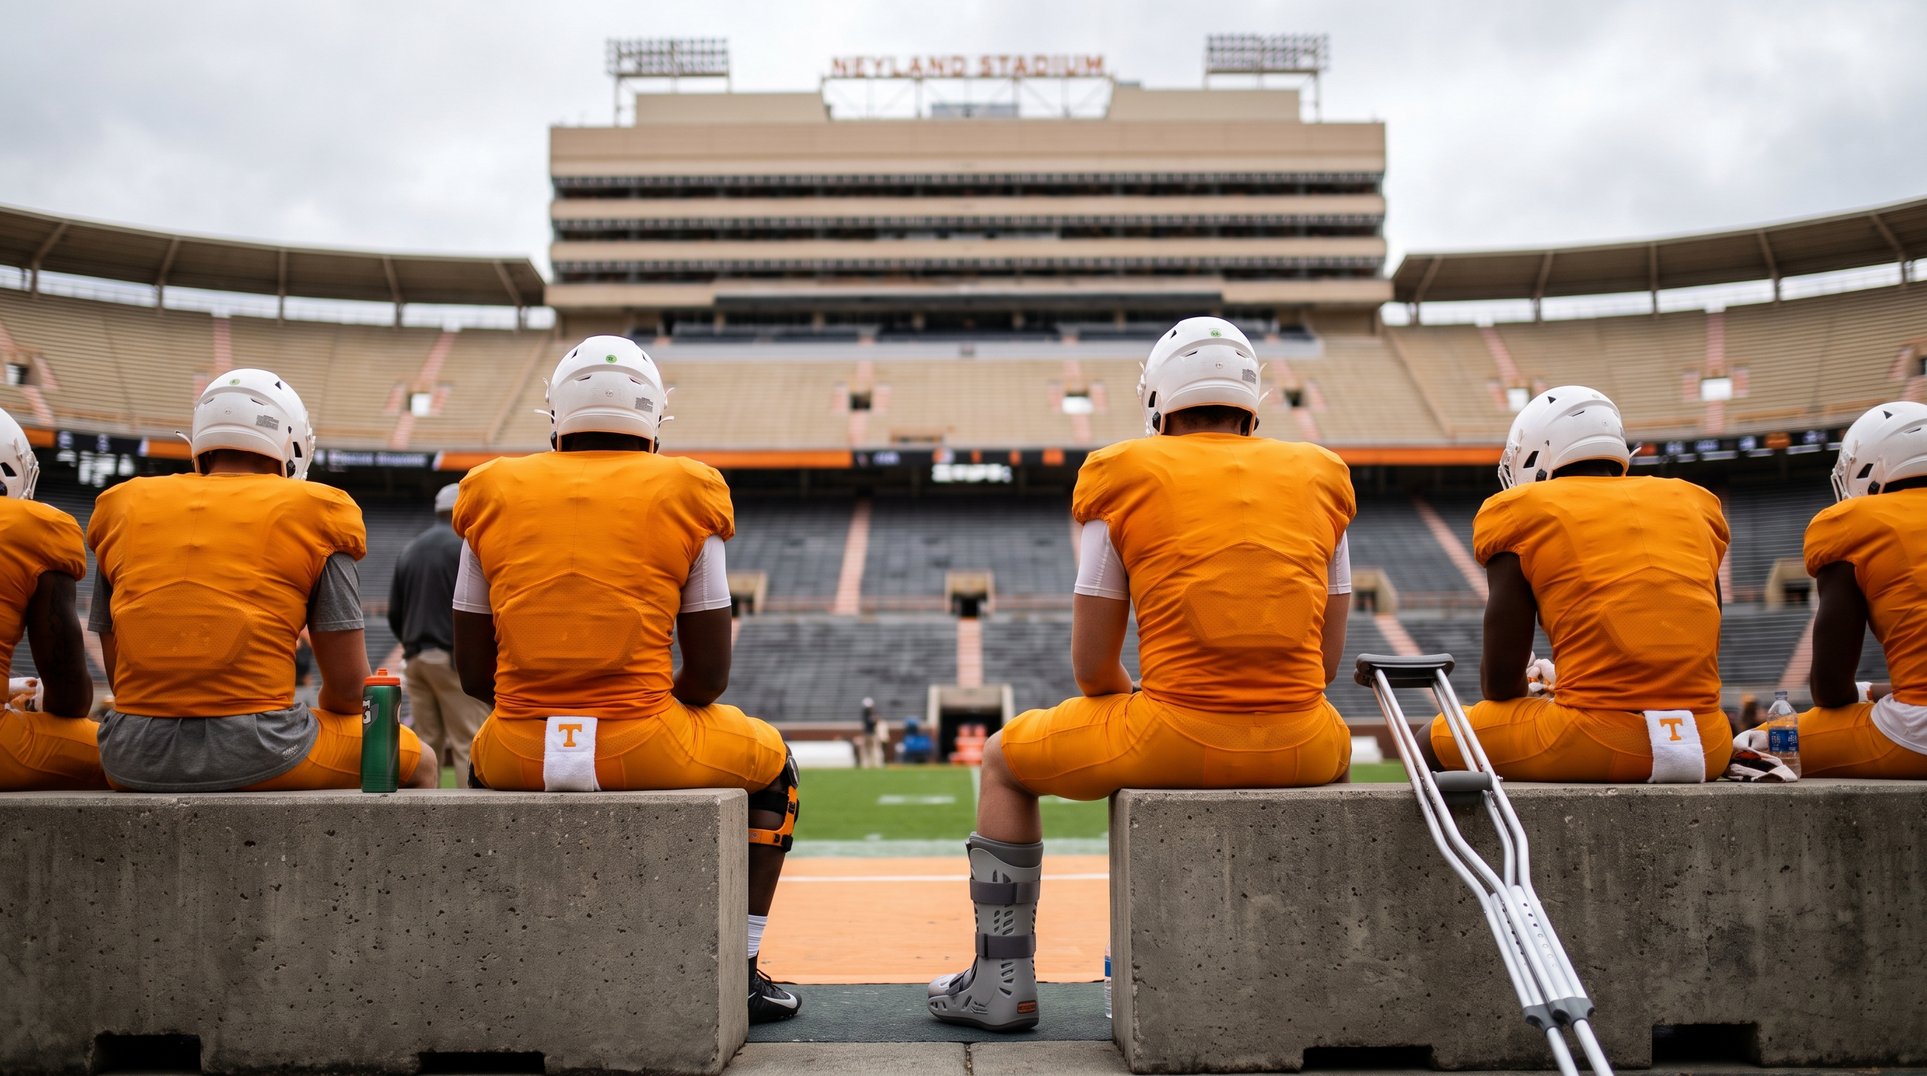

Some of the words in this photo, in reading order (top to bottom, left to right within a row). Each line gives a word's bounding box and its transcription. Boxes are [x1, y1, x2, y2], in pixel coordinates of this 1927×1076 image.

[831, 54, 968, 76] NEYLAND
[978, 54, 1104, 76] STADIUM
[558, 723, 583, 748] T
[1659, 717, 1683, 741] T
